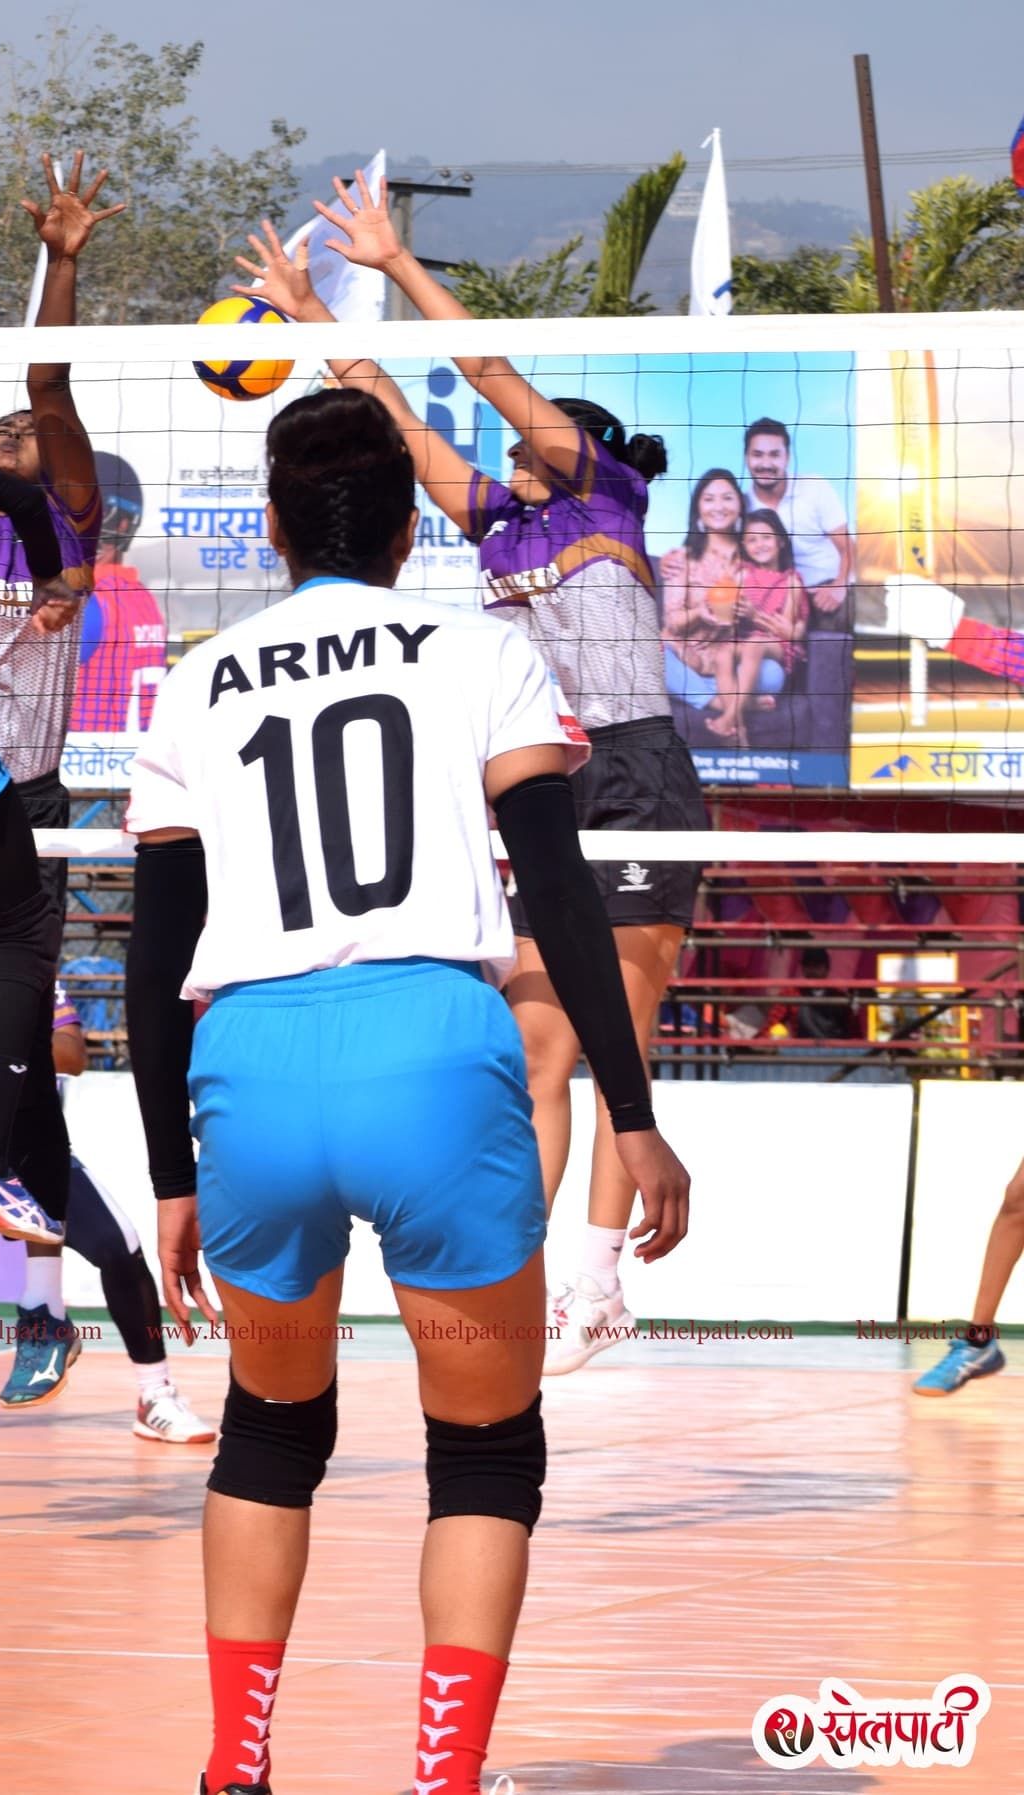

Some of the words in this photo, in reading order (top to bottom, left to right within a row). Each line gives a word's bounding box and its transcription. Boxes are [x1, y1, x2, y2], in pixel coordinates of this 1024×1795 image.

[160, 507, 266, 538] सगरम
[209, 623, 440, 709] ARMY
[238, 693, 414, 932] 10
